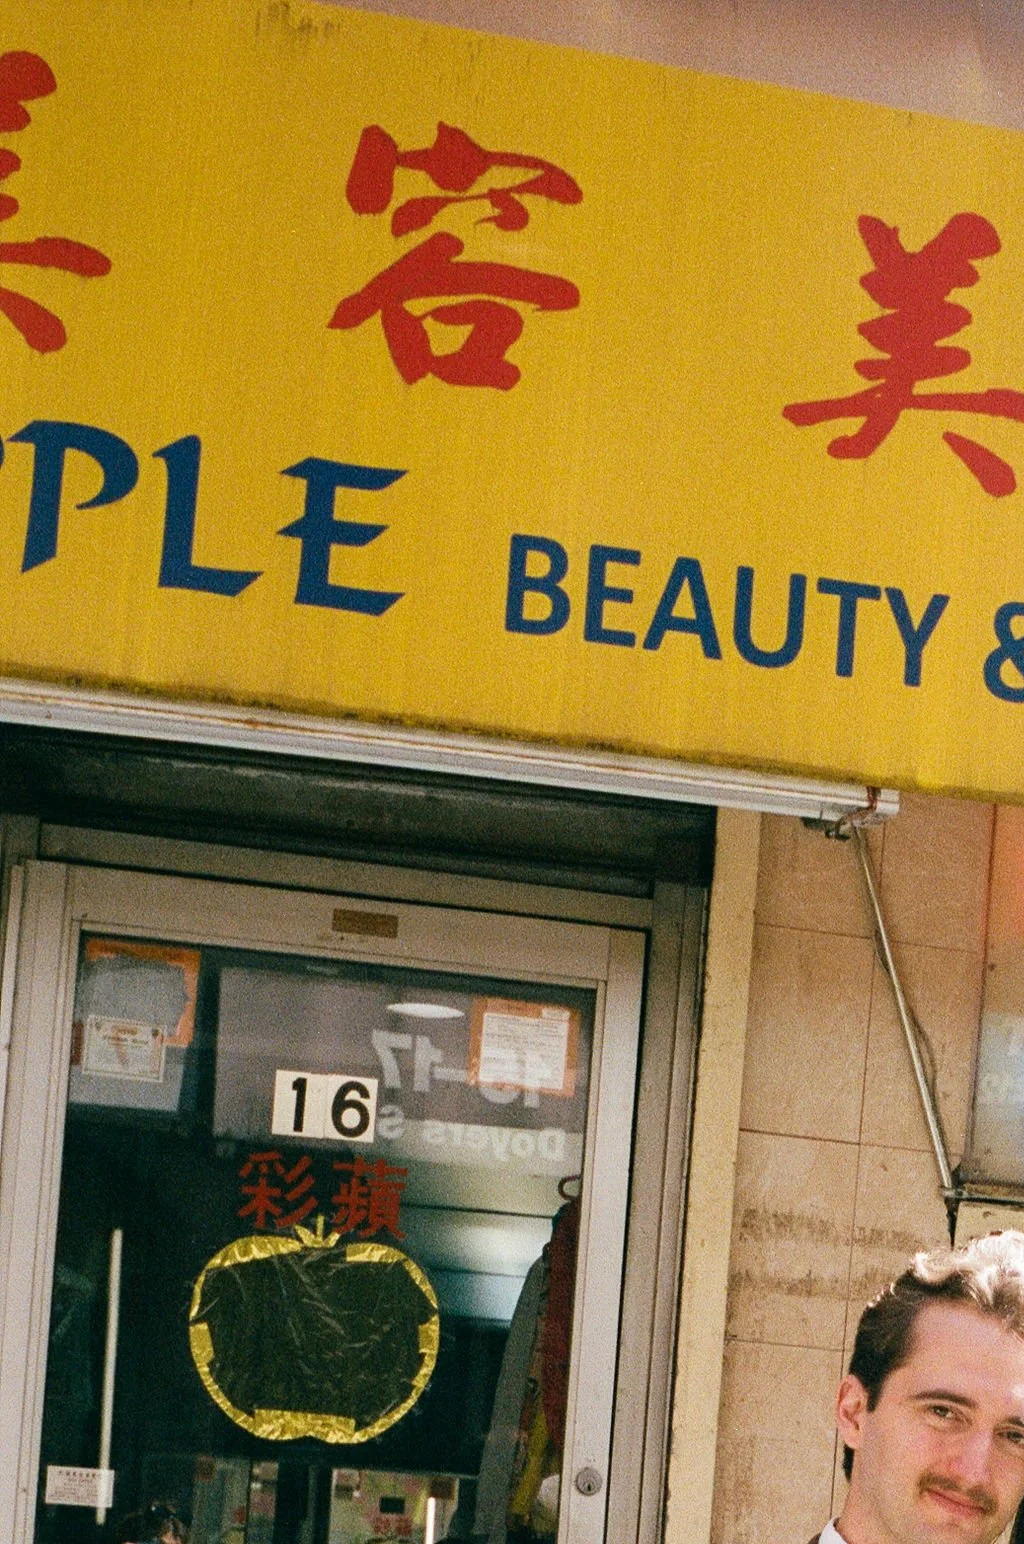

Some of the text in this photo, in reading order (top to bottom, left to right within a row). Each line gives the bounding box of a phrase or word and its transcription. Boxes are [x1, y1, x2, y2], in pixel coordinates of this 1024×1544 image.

[0, 420, 408, 615] PLE
[505, 535, 950, 688] BEAUTY
[290, 1077, 371, 1138] 16
[238, 1151, 409, 1241] 彩蘋
